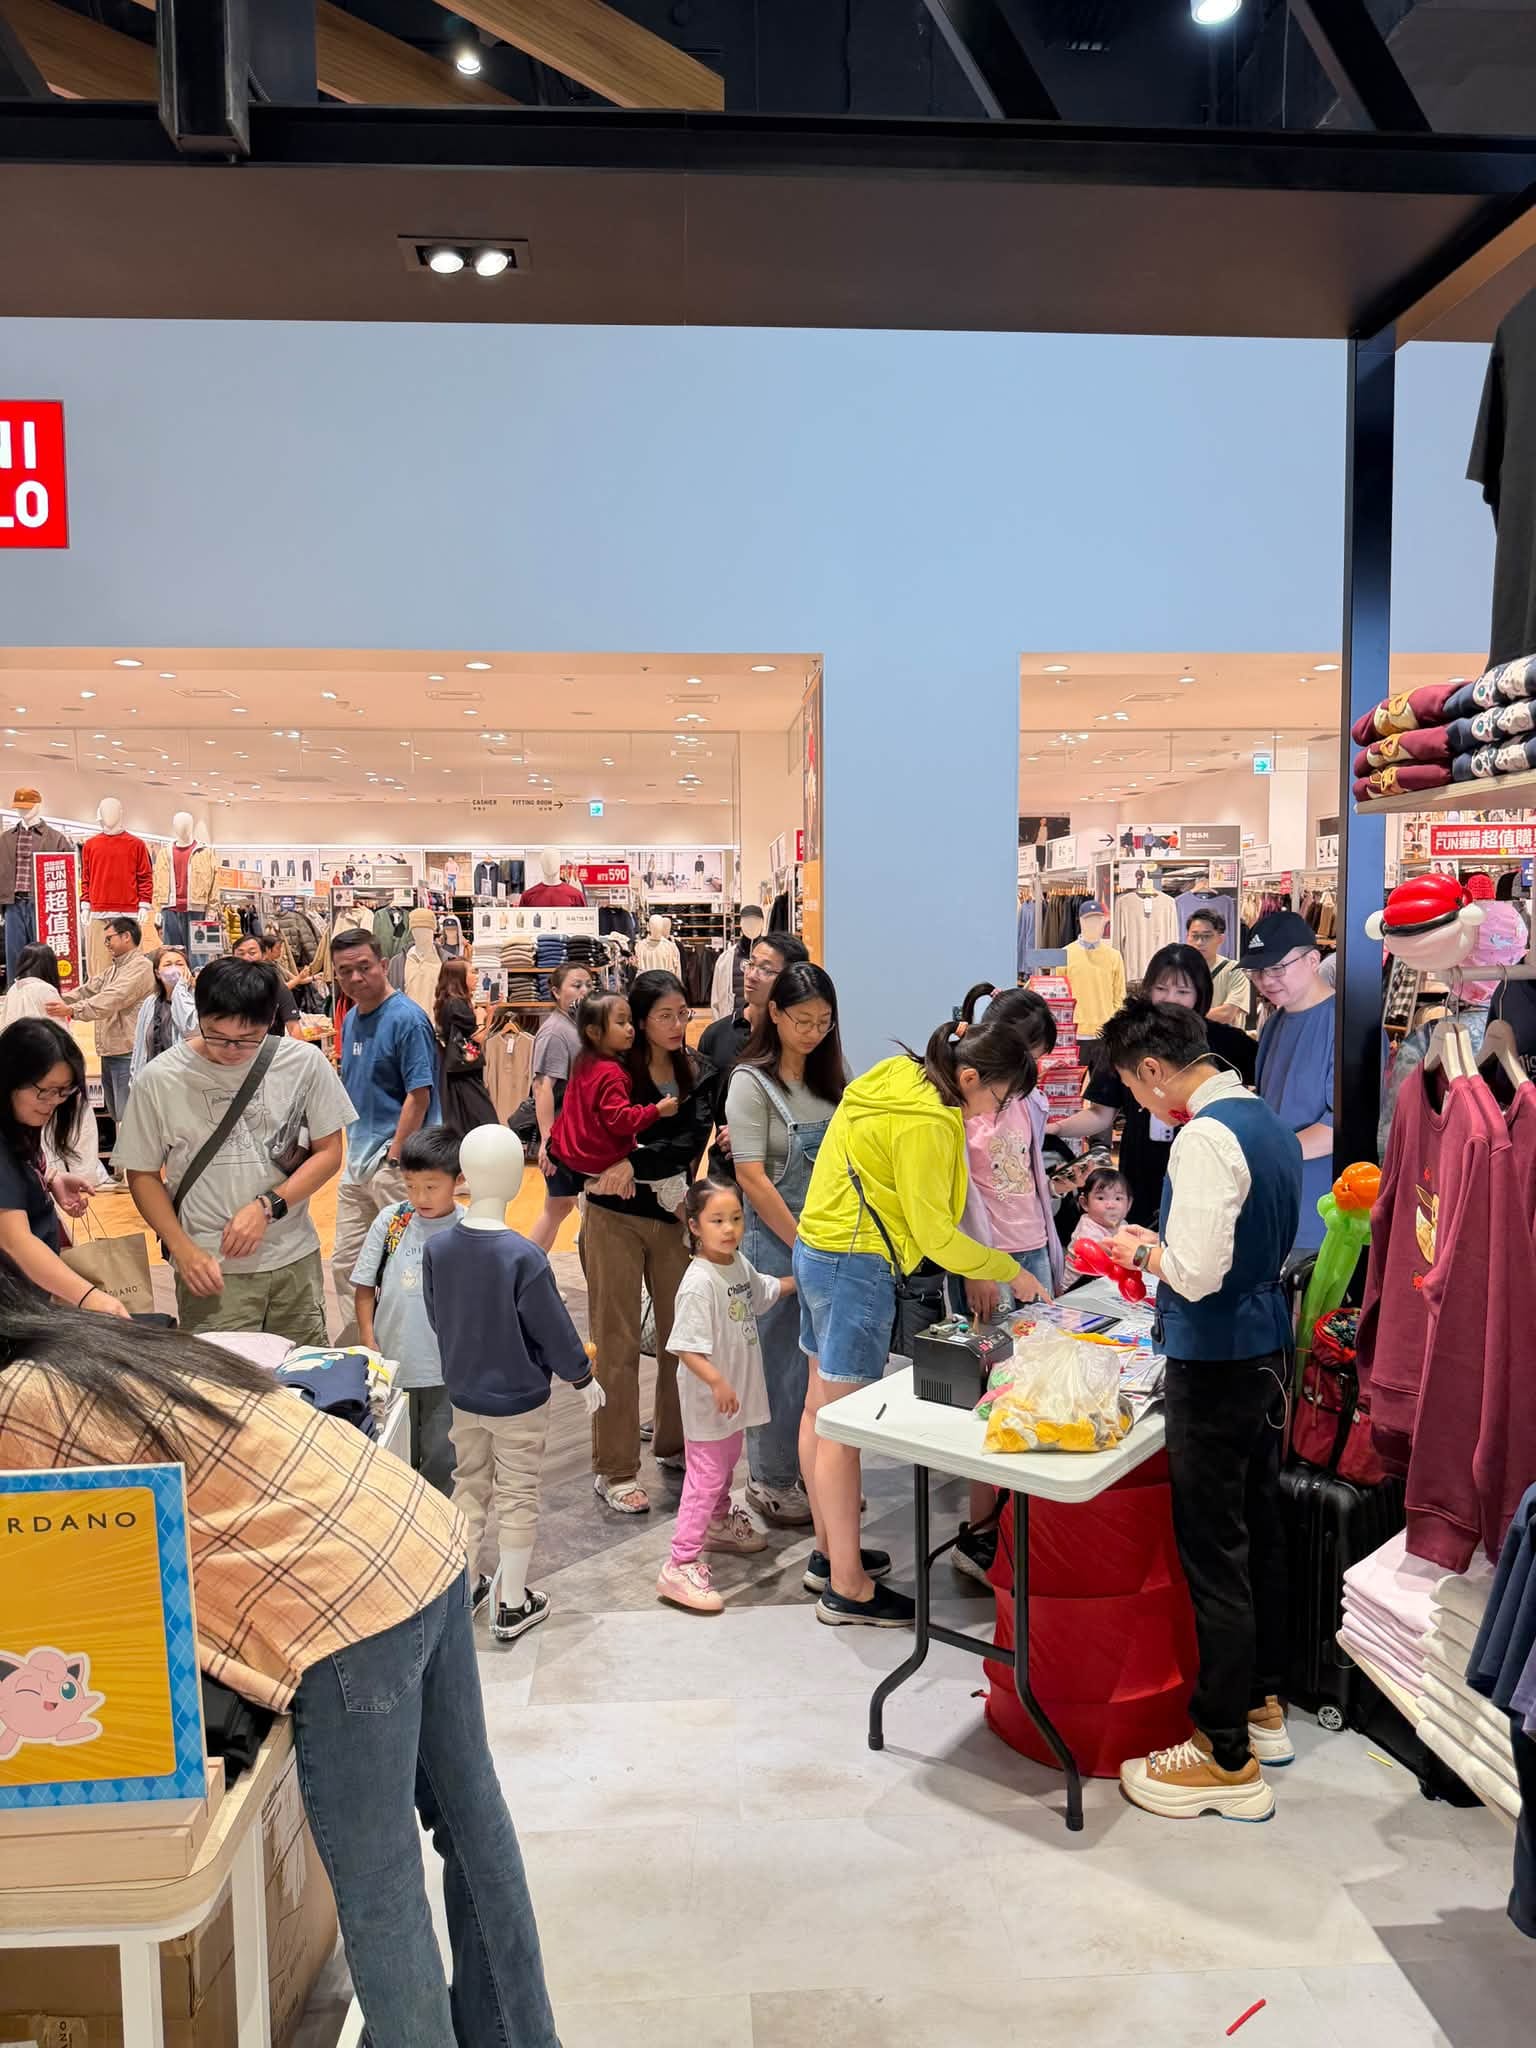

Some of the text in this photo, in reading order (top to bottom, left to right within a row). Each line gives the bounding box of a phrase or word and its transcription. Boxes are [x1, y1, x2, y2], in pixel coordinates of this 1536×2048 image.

[44, 869, 67, 881] FUN
[45, 890, 70, 957] 超值購
[7, 1511, 137, 1535] RDANO
